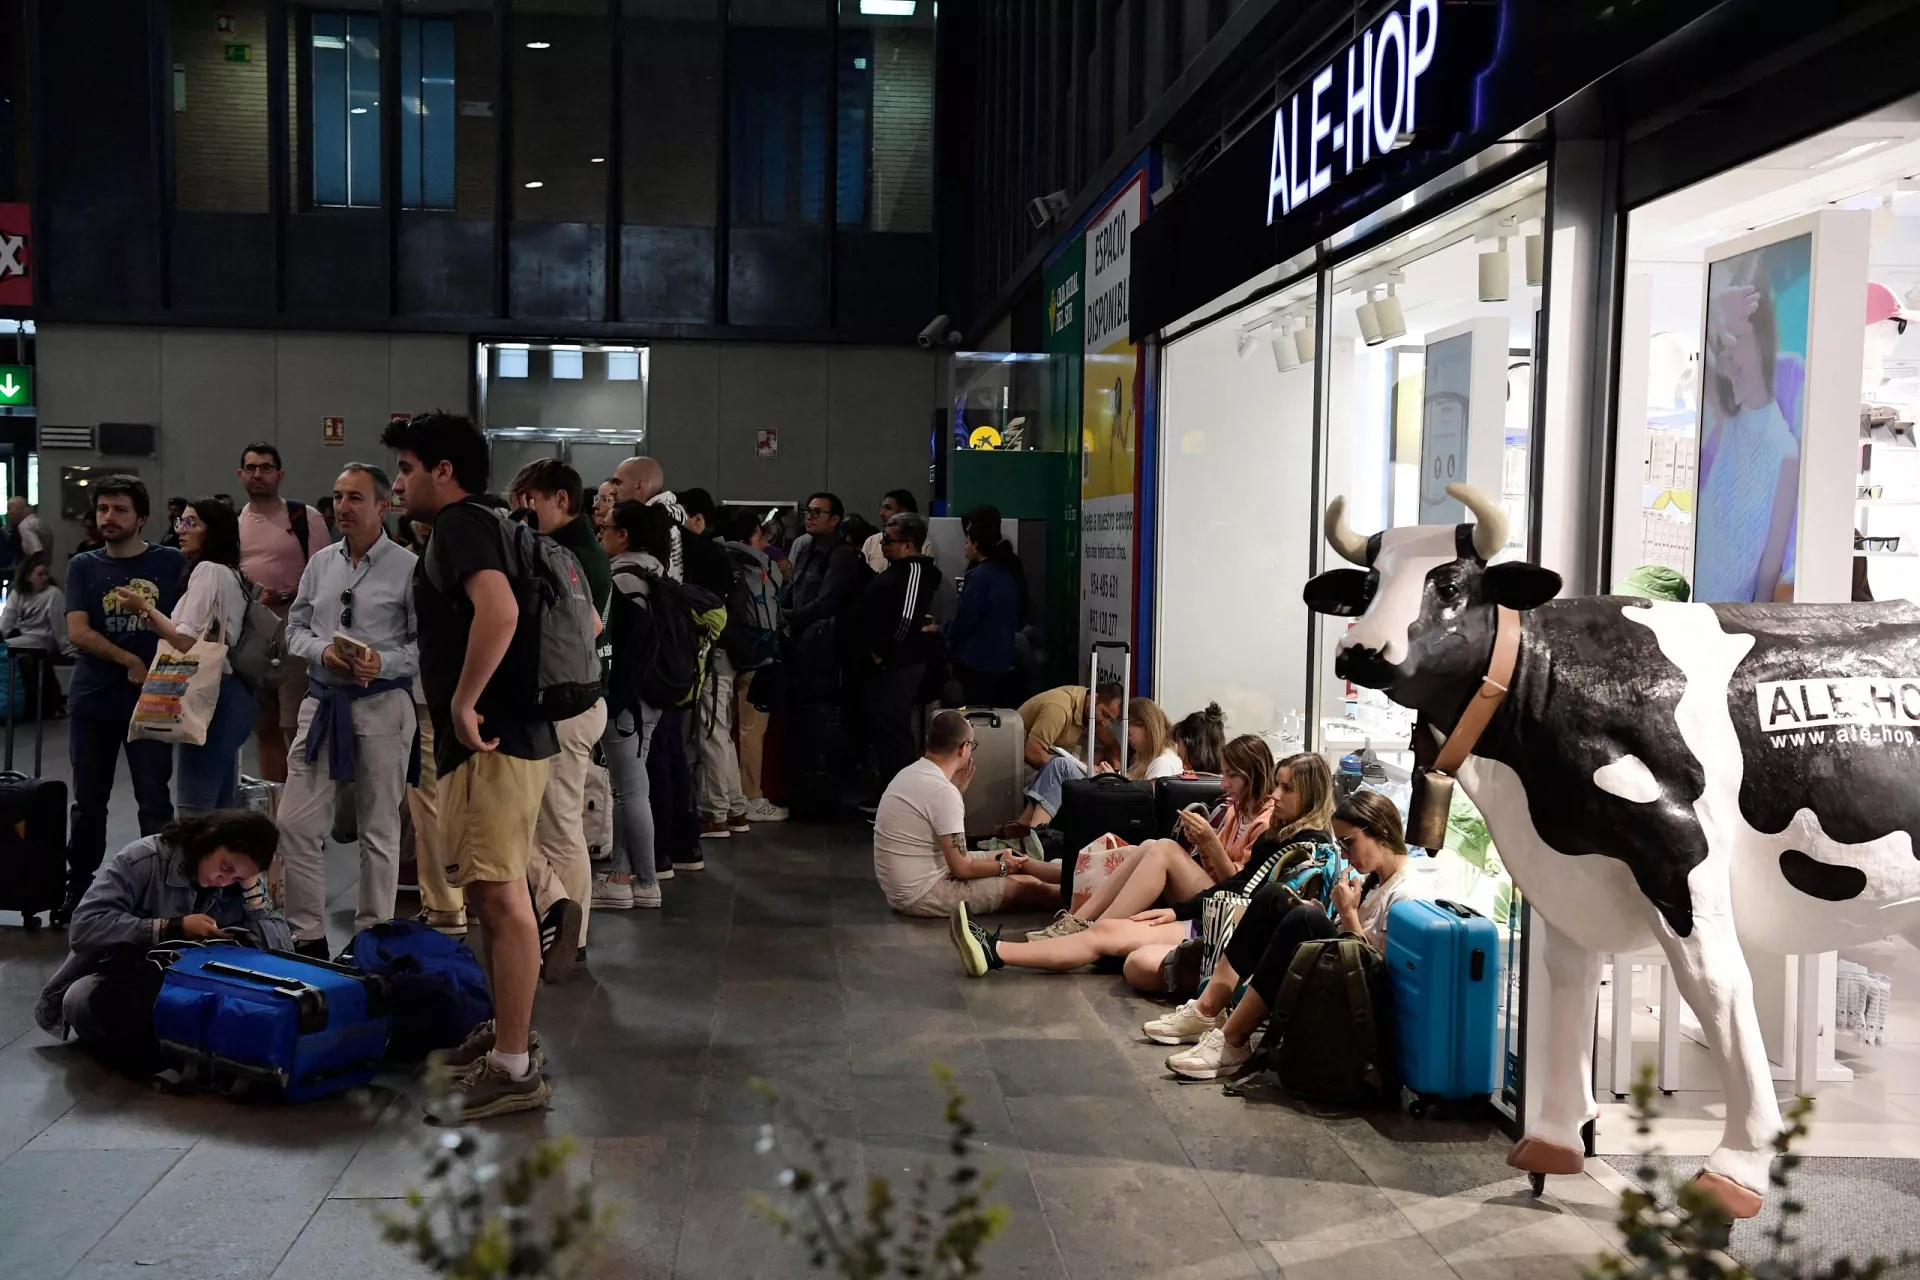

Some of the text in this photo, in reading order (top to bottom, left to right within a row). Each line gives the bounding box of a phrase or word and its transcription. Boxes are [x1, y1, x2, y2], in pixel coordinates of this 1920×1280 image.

[1266, 0, 1439, 226] ALE-HOP
[1095, 209, 1126, 277] ESPACIO
[1087, 278, 1130, 346] DISPONIBL
[105, 613, 150, 633] SPAC
